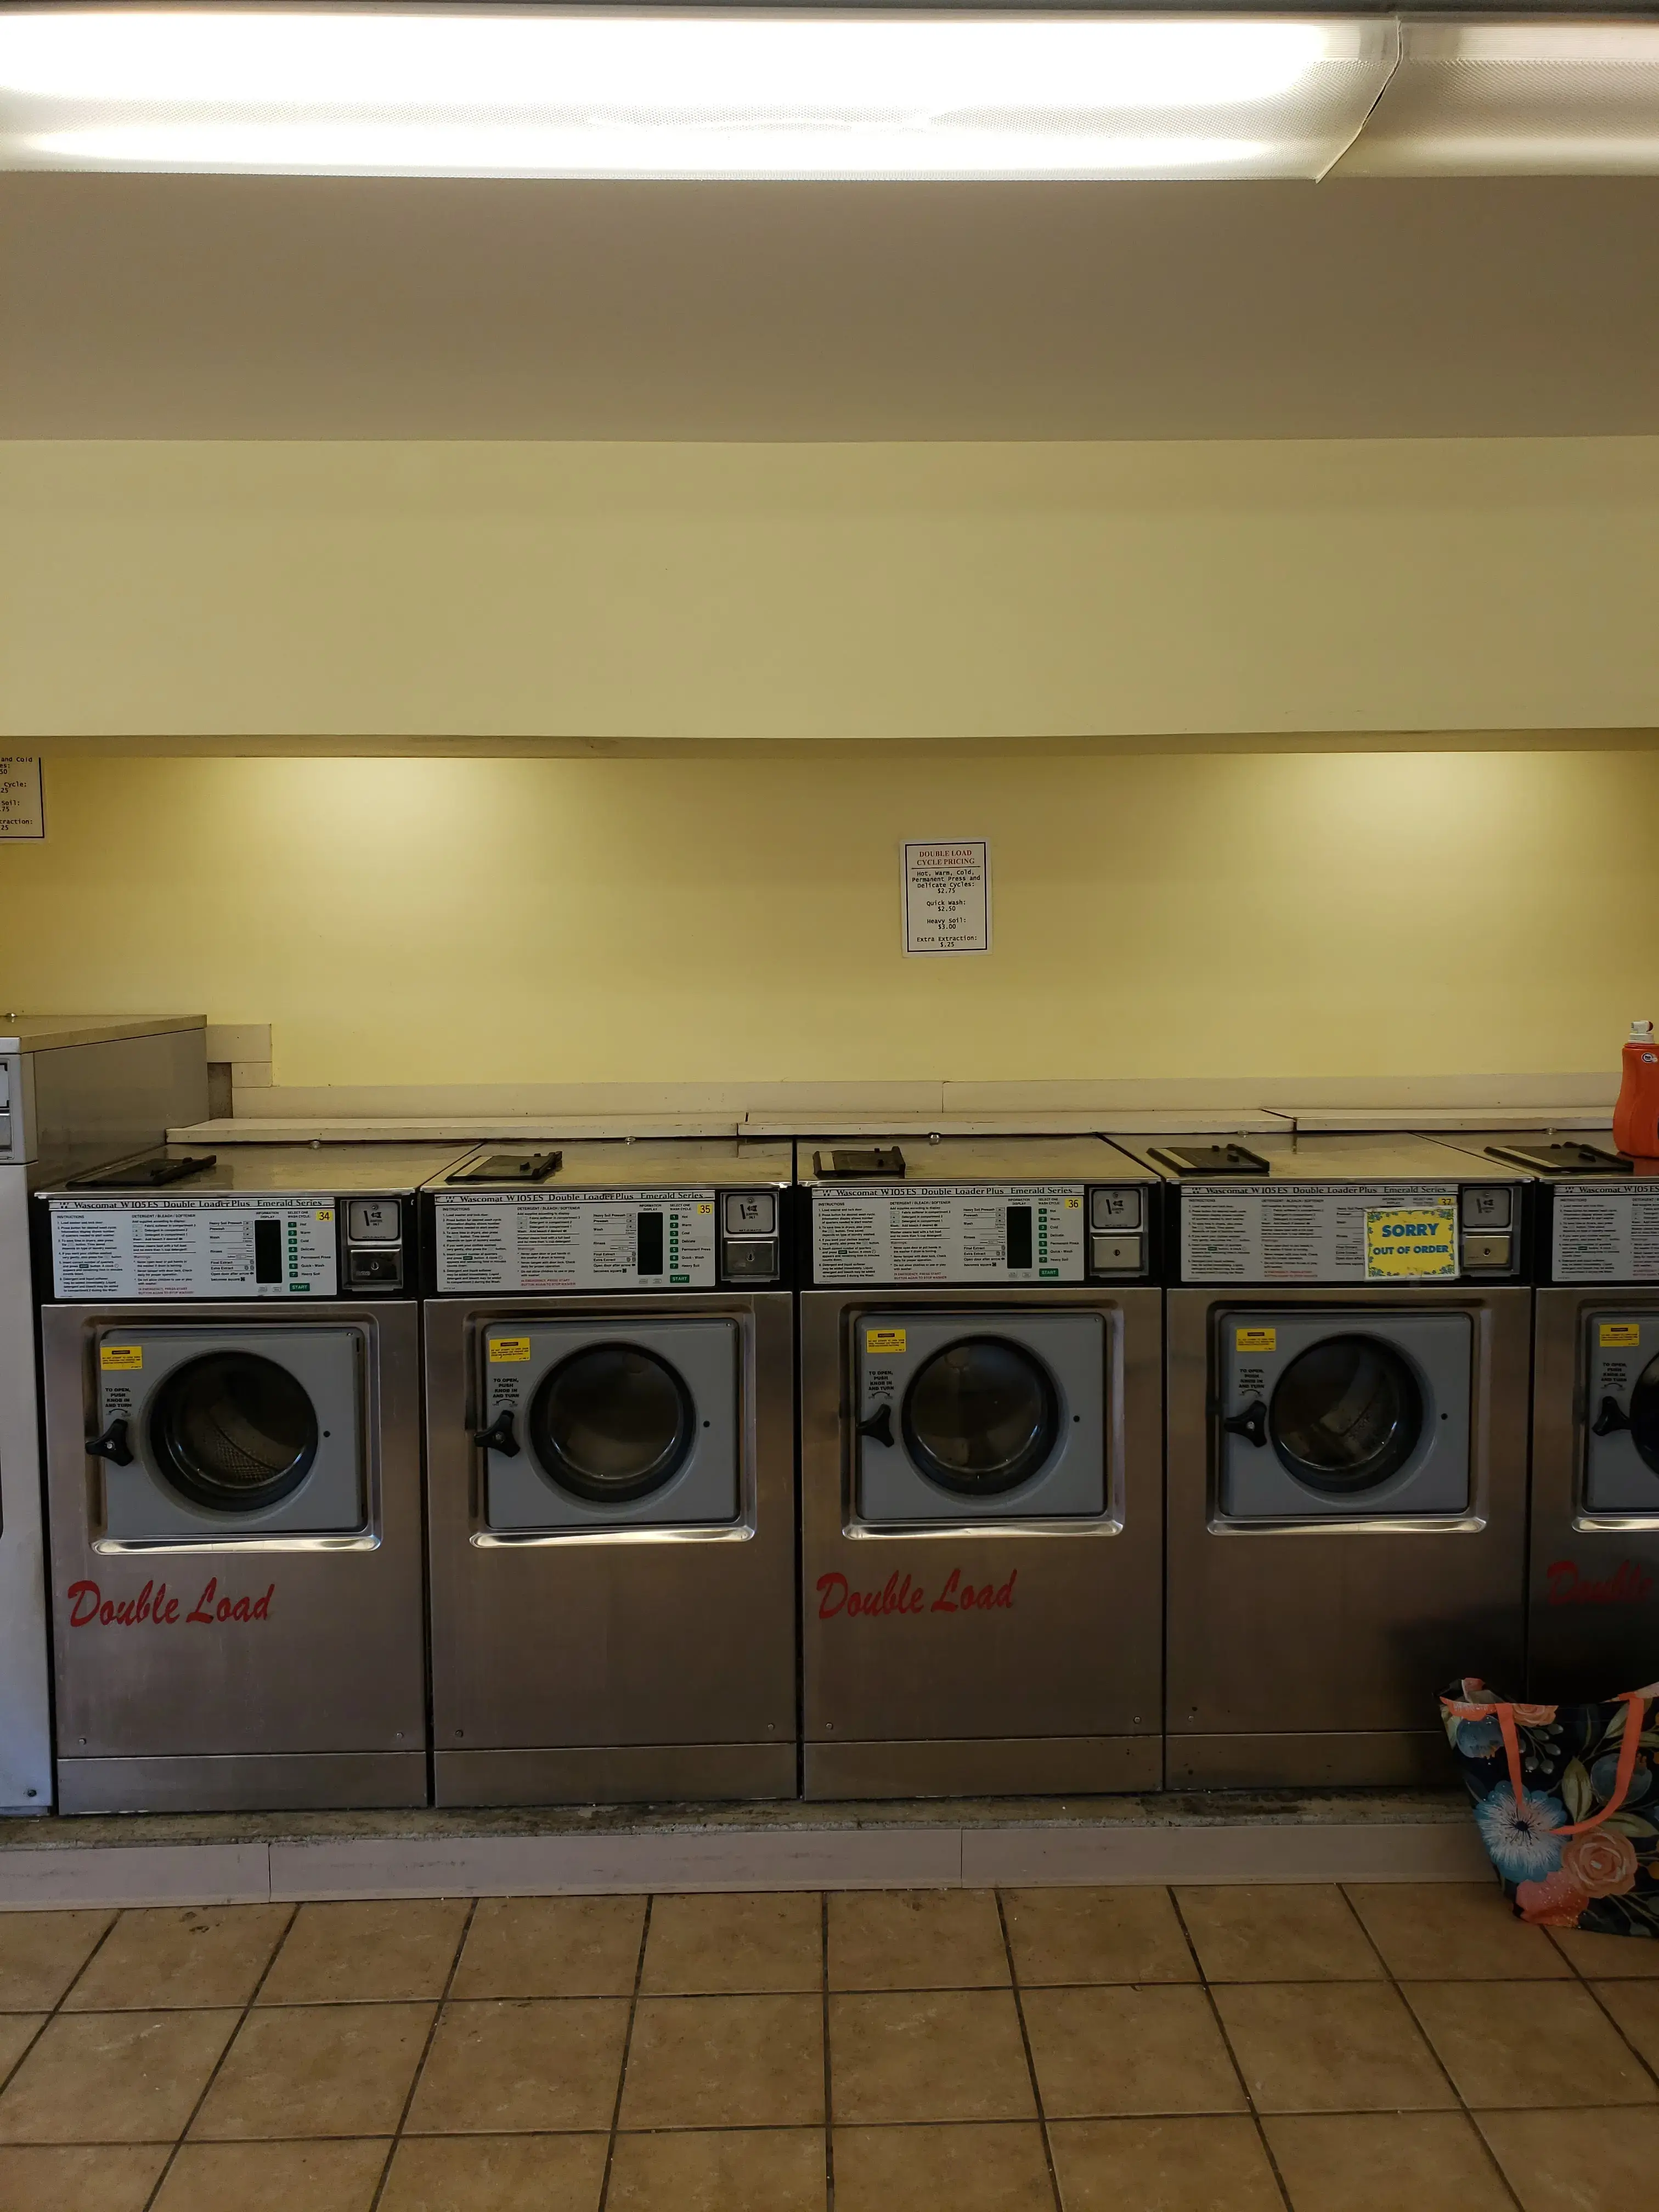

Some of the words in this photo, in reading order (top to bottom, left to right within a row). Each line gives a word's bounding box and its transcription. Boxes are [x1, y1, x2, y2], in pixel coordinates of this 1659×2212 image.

[700, 1205, 710, 1214] 35
[1068, 1200, 1079, 1208] 36
[319, 1212, 329, 1220] 34
[1382, 1223, 1438, 1237] SORRY
[1414, 1245, 1448, 1254] ORDER
[1547, 1559, 1654, 1606] Double
[816, 1570, 924, 1620] Double
[930, 1567, 1017, 1613] Load
[67, 1579, 180, 1627] Double
[186, 1577, 275, 1624] Load
